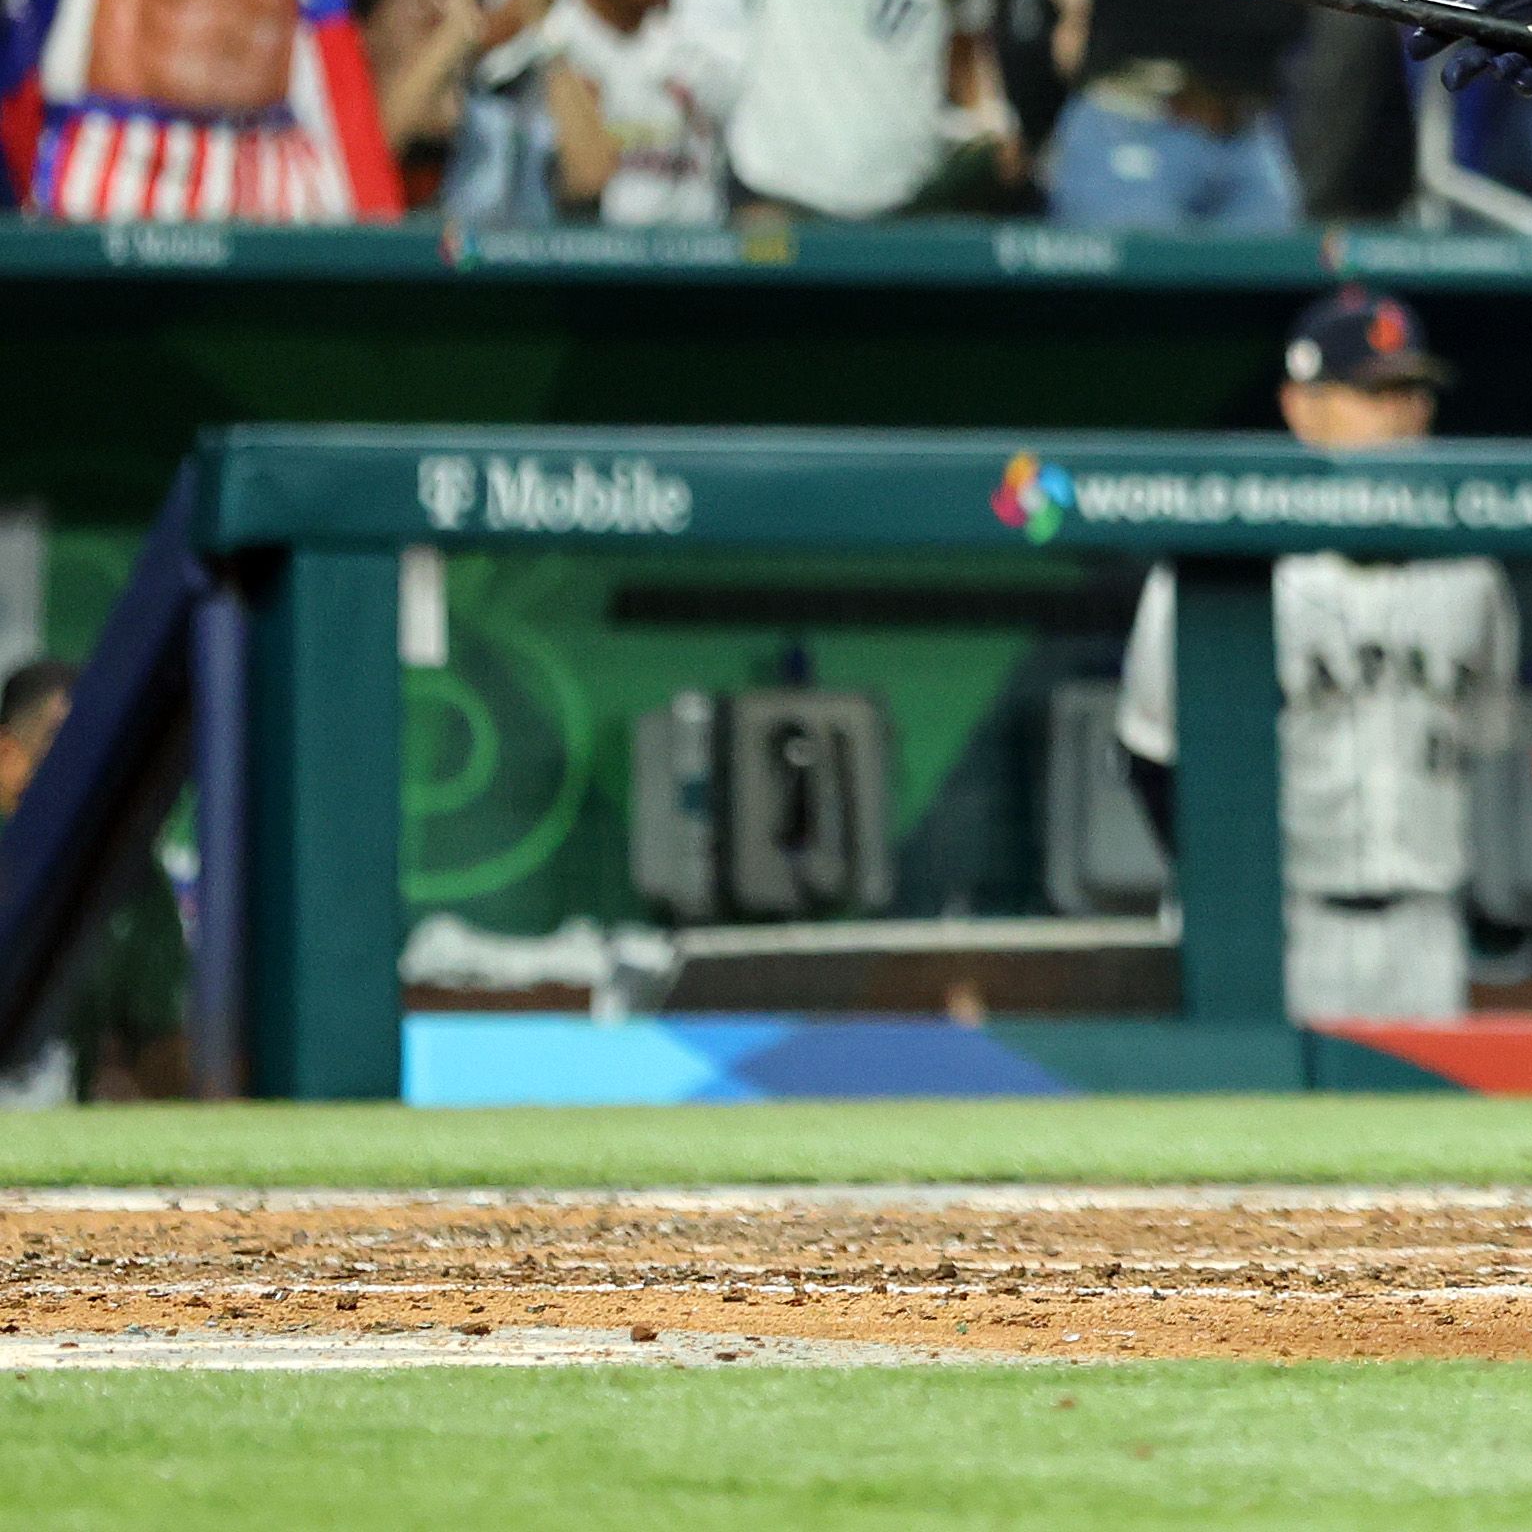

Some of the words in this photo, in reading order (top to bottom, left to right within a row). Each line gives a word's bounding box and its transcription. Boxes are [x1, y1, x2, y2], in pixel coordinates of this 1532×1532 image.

[486, 456, 694, 534] Mobile
[1076, 474, 1231, 523] WORLD
[1237, 475, 1452, 527] BASEBALL
